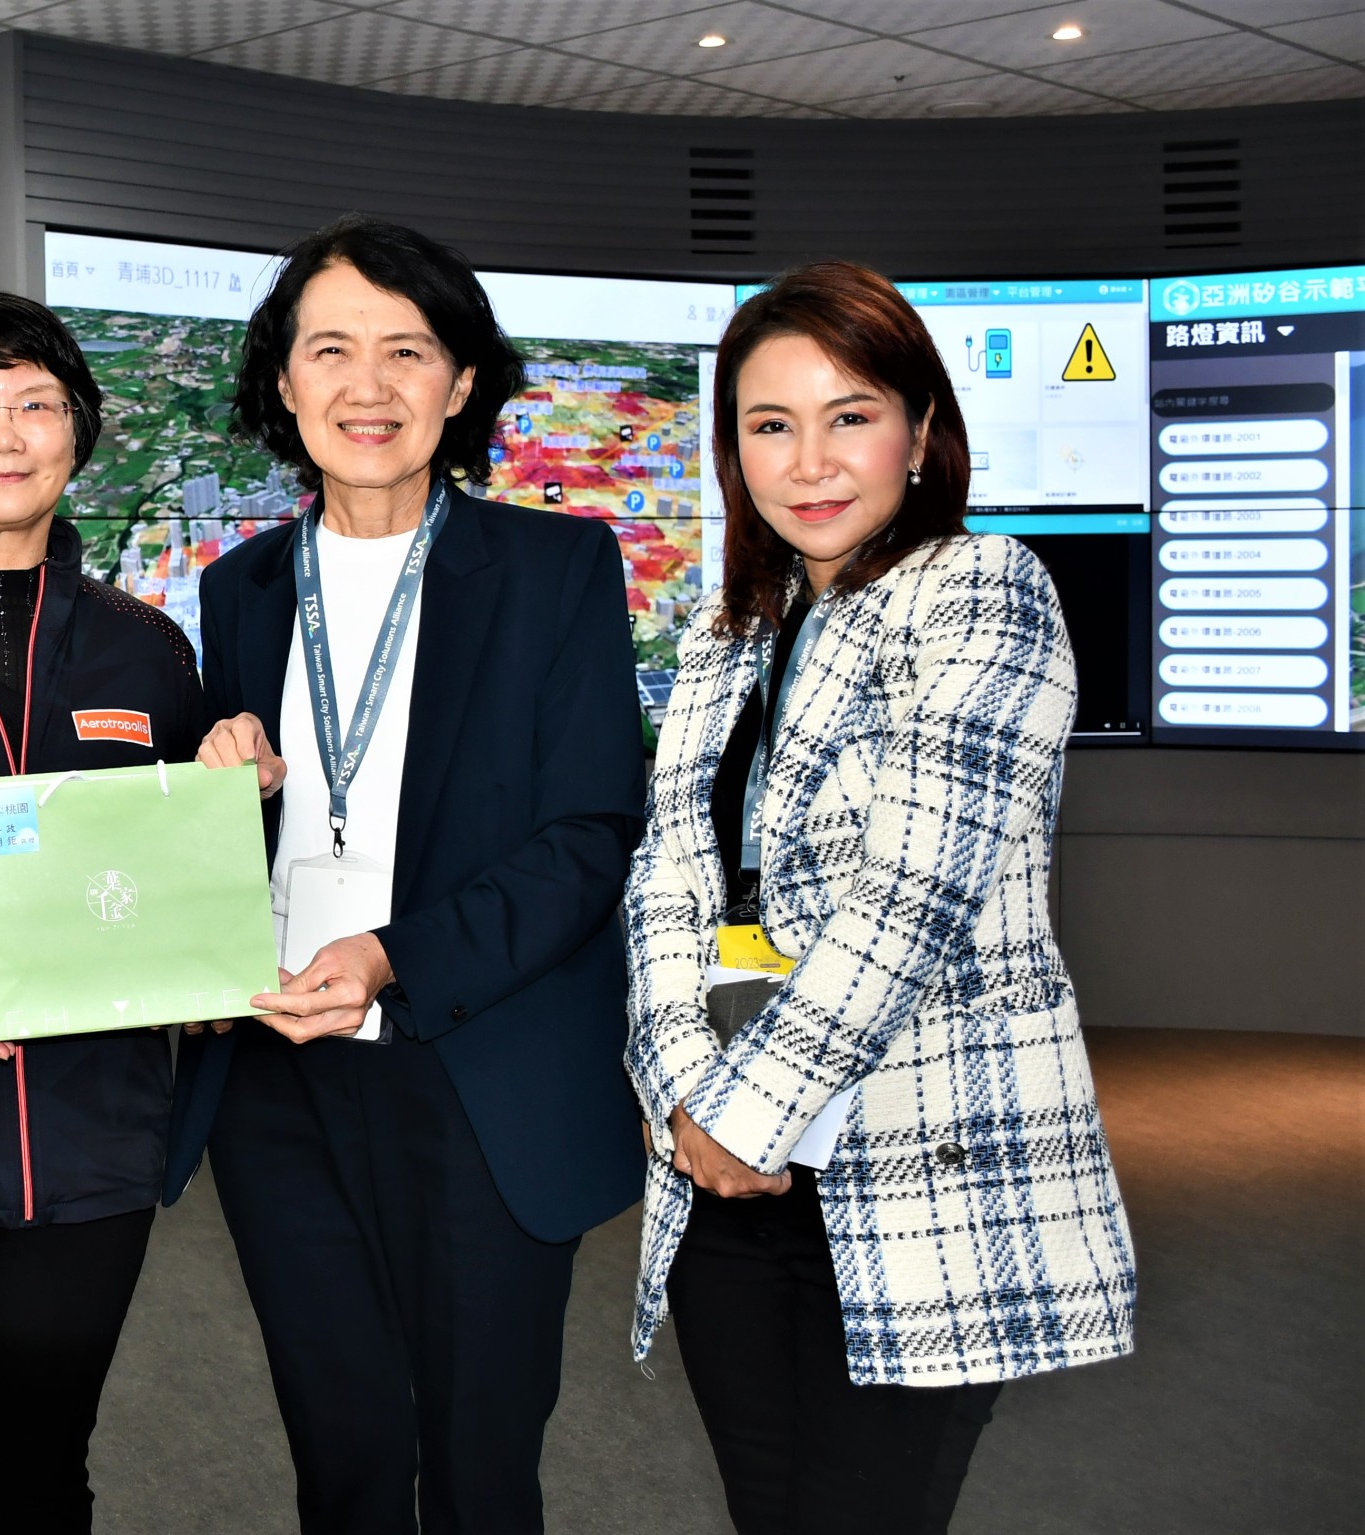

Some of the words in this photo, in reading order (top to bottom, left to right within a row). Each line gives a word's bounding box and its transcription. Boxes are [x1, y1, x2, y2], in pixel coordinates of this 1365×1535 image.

[52, 261, 78, 279] 首頁
[118, 261, 219, 289] 青埔3D_1117
[1007, 285, 1052, 299] 平台管理
[1166, 320, 1265, 347] 路燈資訊
[425, 503, 441, 527] Taiwan
[301, 546, 311, 577] Alliance
[405, 539, 425, 576] TSSA
[304, 593, 320, 632] TSSA
[391, 593, 406, 626] Alliance
[313, 643, 323, 673] Taiwan
[379, 626, 396, 664] Solutions
[317, 674, 327, 697] Smart
[373, 663, 386, 682] City
[782, 673, 801, 713] Solutions
[796, 638, 813, 671] Alliance
[320, 698, 330, 714] City
[365, 682, 379, 706] Smart
[80, 719, 148, 735] Aerotropolis
[323, 715, 333, 753] Solutions
[355, 707, 371, 736] Taiwan
[337, 749, 359, 786] TSSA
[5, 803, 28, 814] 桃園
[734, 957, 759, 969] 2023
